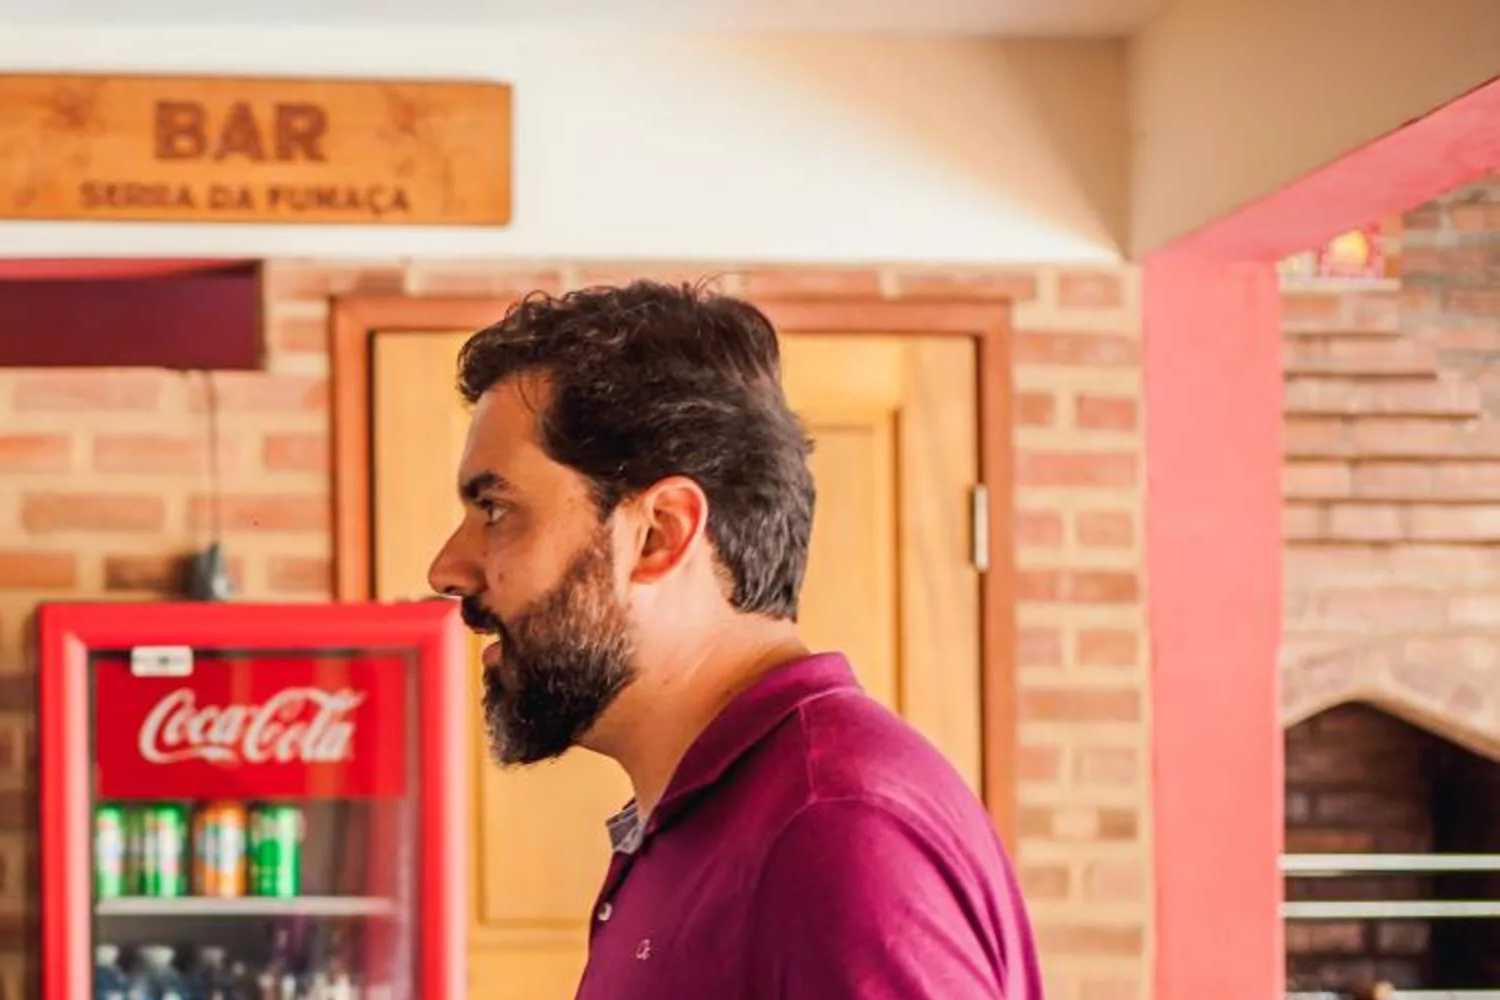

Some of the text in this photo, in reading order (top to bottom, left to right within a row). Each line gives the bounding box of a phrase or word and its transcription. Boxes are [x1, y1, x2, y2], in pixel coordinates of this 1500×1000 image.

[153, 99, 329, 163] BAR
[208, 184, 256, 211] DA
[266, 184, 412, 218] FUMAÇA
